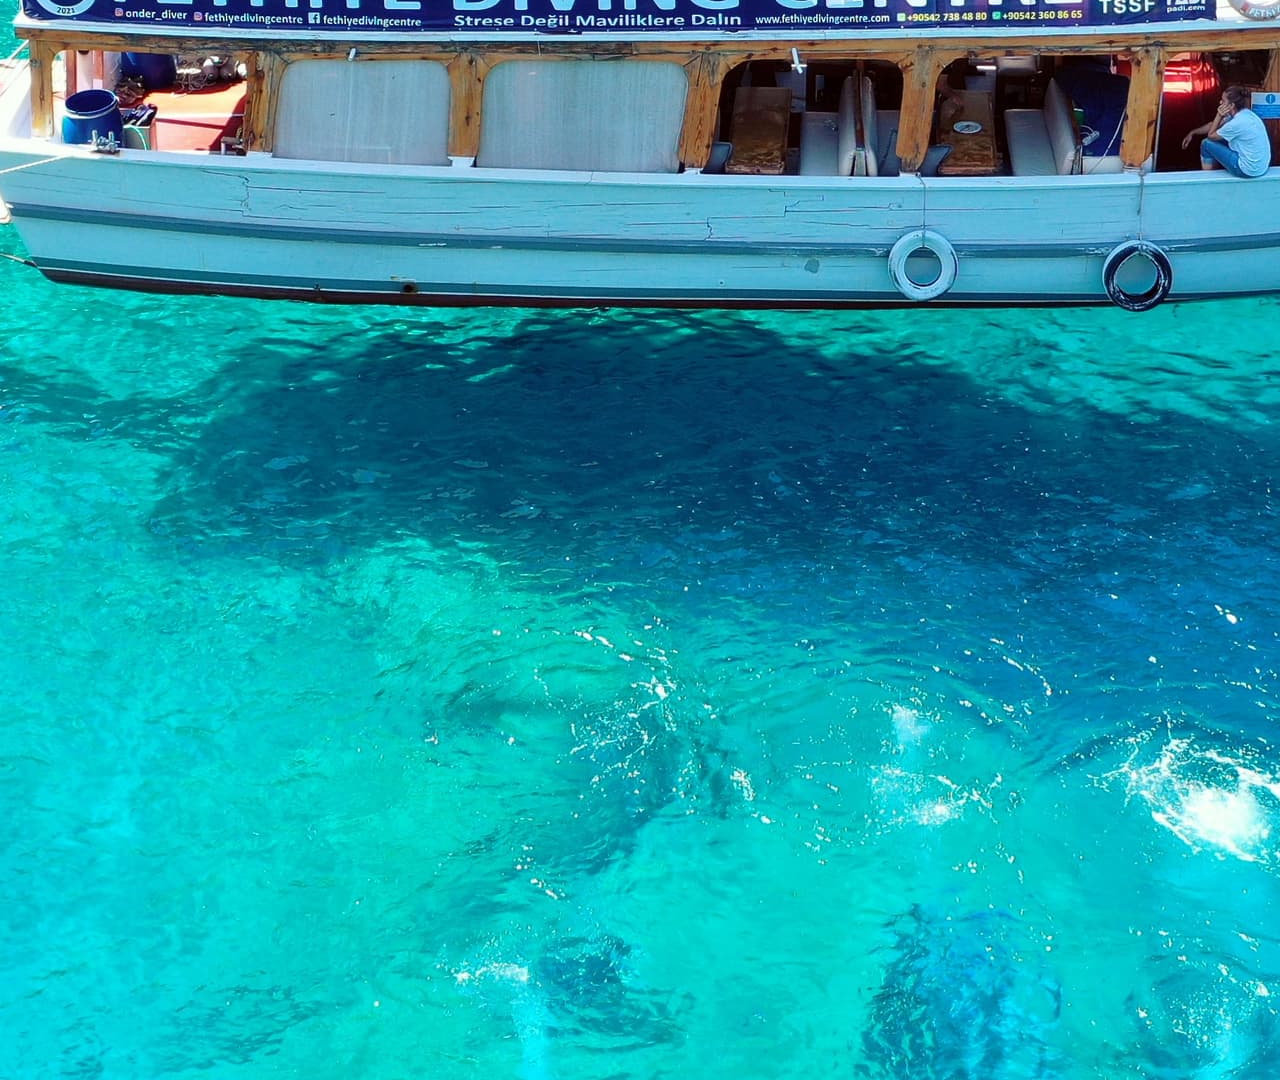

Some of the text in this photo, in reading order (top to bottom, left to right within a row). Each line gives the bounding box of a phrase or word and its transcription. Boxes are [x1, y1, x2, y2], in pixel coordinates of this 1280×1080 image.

[56, 6, 76, 15] 2021
[125, 8, 188, 21] onder_diver
[1002, 10, 1083, 21] +90542 360 86 65
[204, 12, 303, 25] fethiyedivingcentre
[322, 14, 423, 28] fethiyedivingcentre
[453, 13, 742, 28] Strese Değil Maviliklere Dalın
[755, 13, 891, 25] www.fethiyedivingcentre.com
[907, 12, 988, 22] +90542 738 48 80
